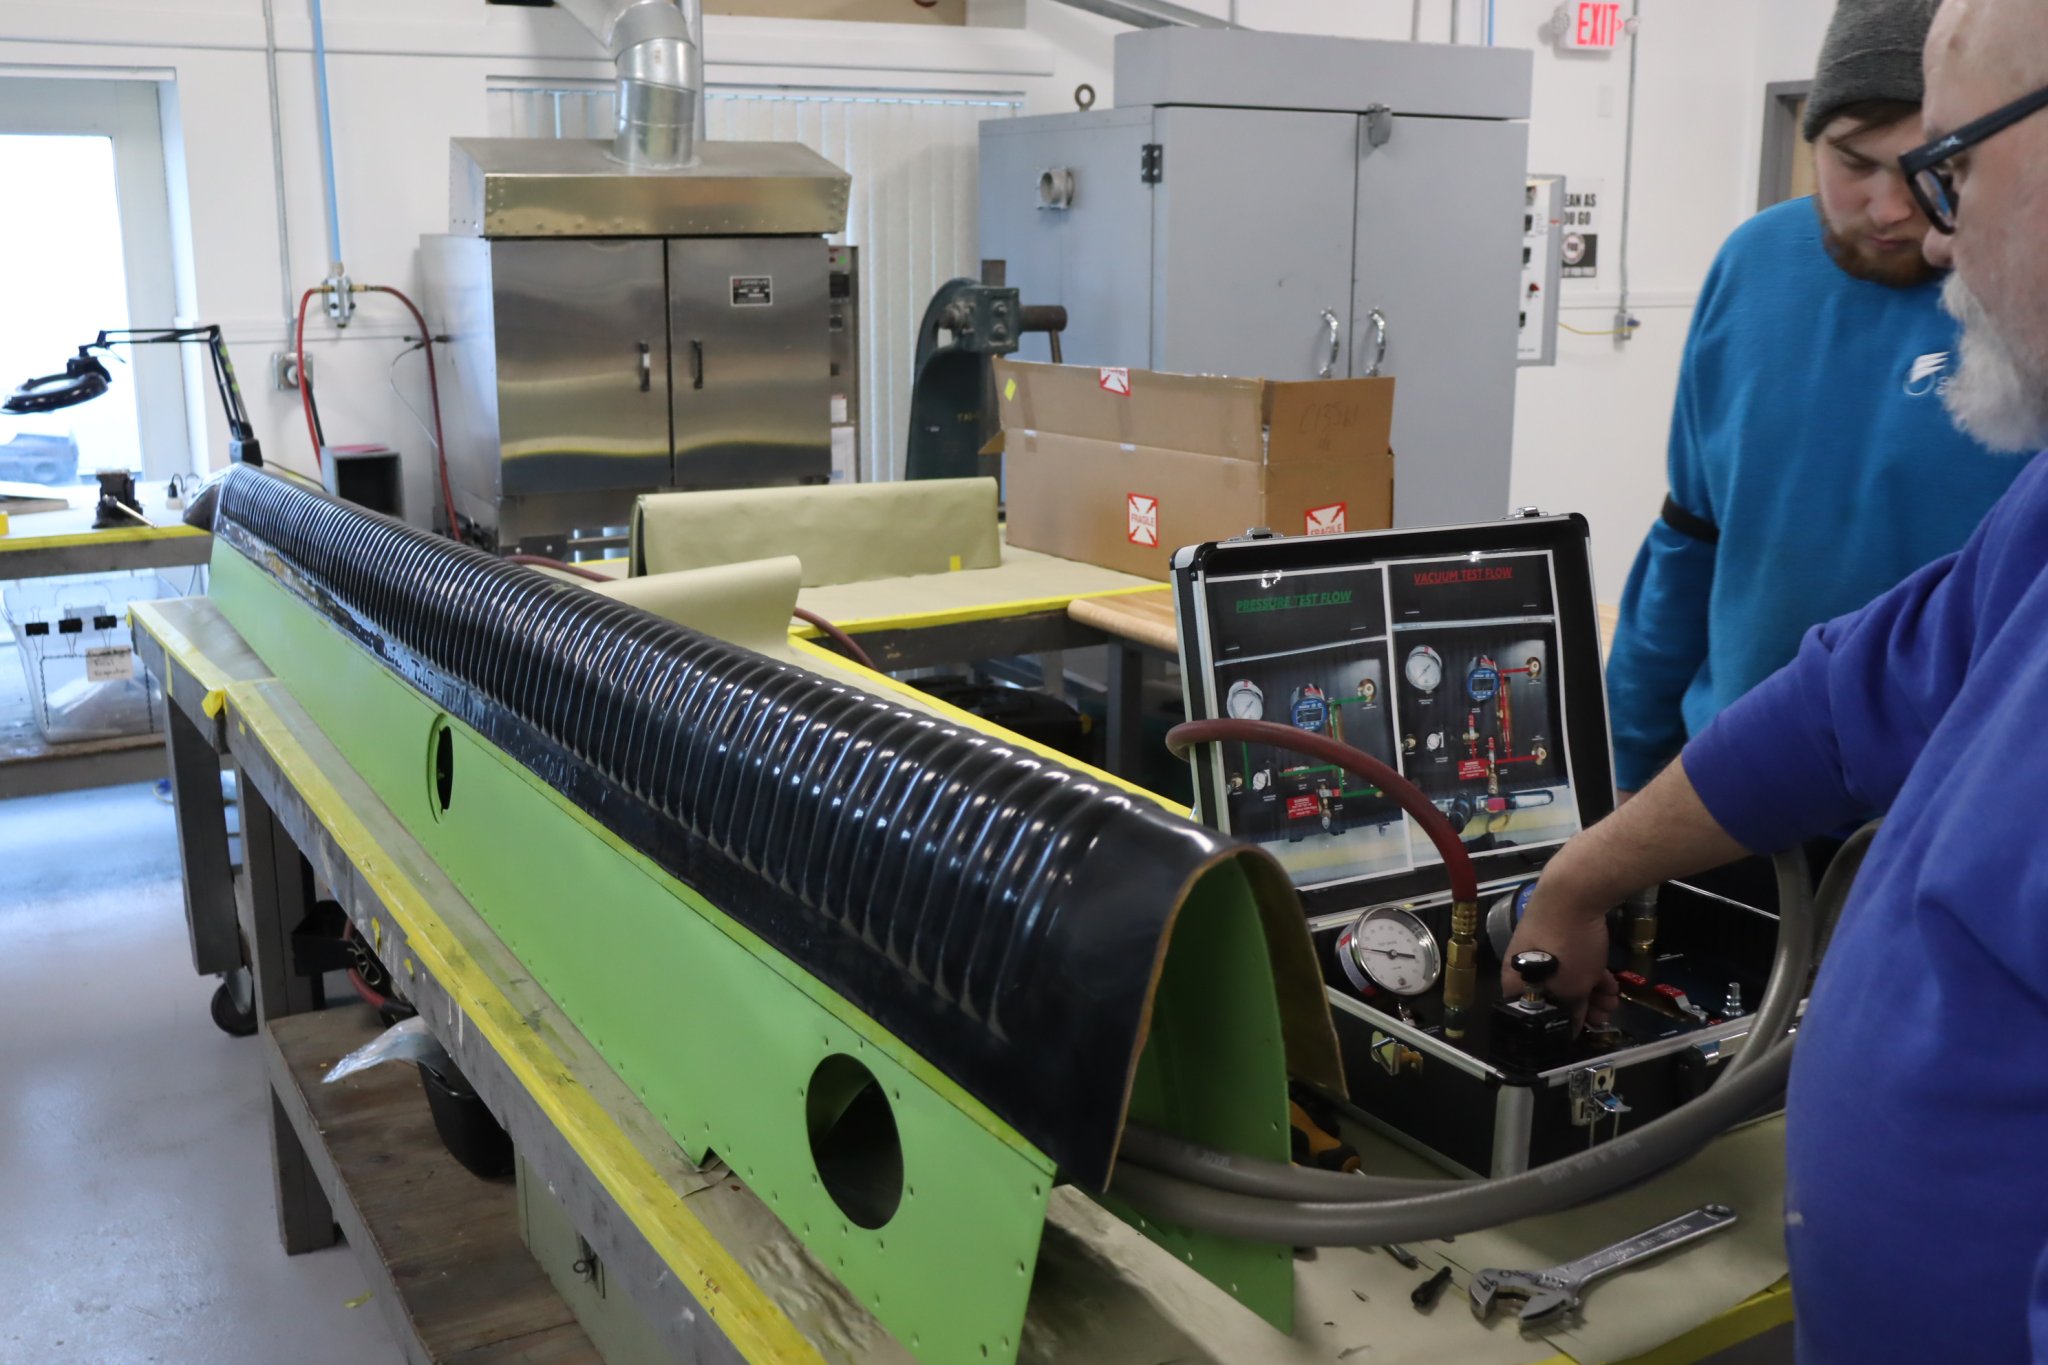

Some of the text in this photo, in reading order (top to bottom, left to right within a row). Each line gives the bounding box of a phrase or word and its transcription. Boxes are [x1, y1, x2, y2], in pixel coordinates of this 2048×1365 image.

[1577, 3, 1619, 46] EXIT
[1584, 193, 1596, 207] AS
[1578, 211, 1591, 225] GO
[1131, 513, 1155, 527] FRAGILE
[1414, 566, 1512, 585] VACUUM TEST FLOW
[1236, 590, 1352, 613] PRESSURE TEST FLOW
